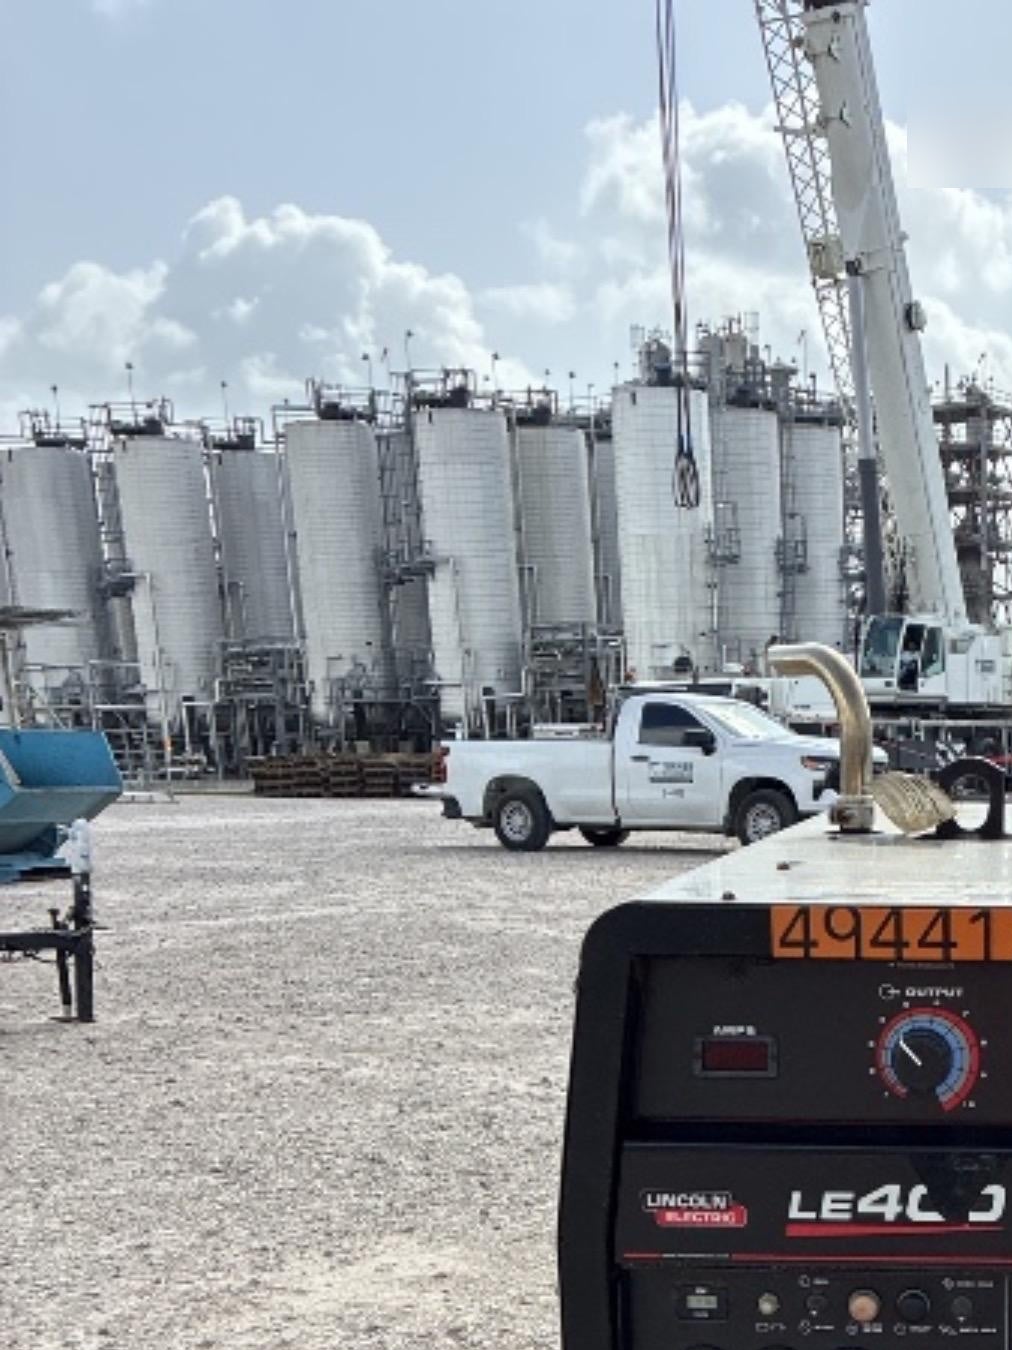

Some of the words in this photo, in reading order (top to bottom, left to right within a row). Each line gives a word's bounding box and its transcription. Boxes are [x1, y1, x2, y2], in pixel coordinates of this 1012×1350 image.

[905, 986, 963, 997] OUTPUT
[646, 1193, 727, 1210] LINCOLN
[664, 1211, 736, 1223] ELECTRIC
